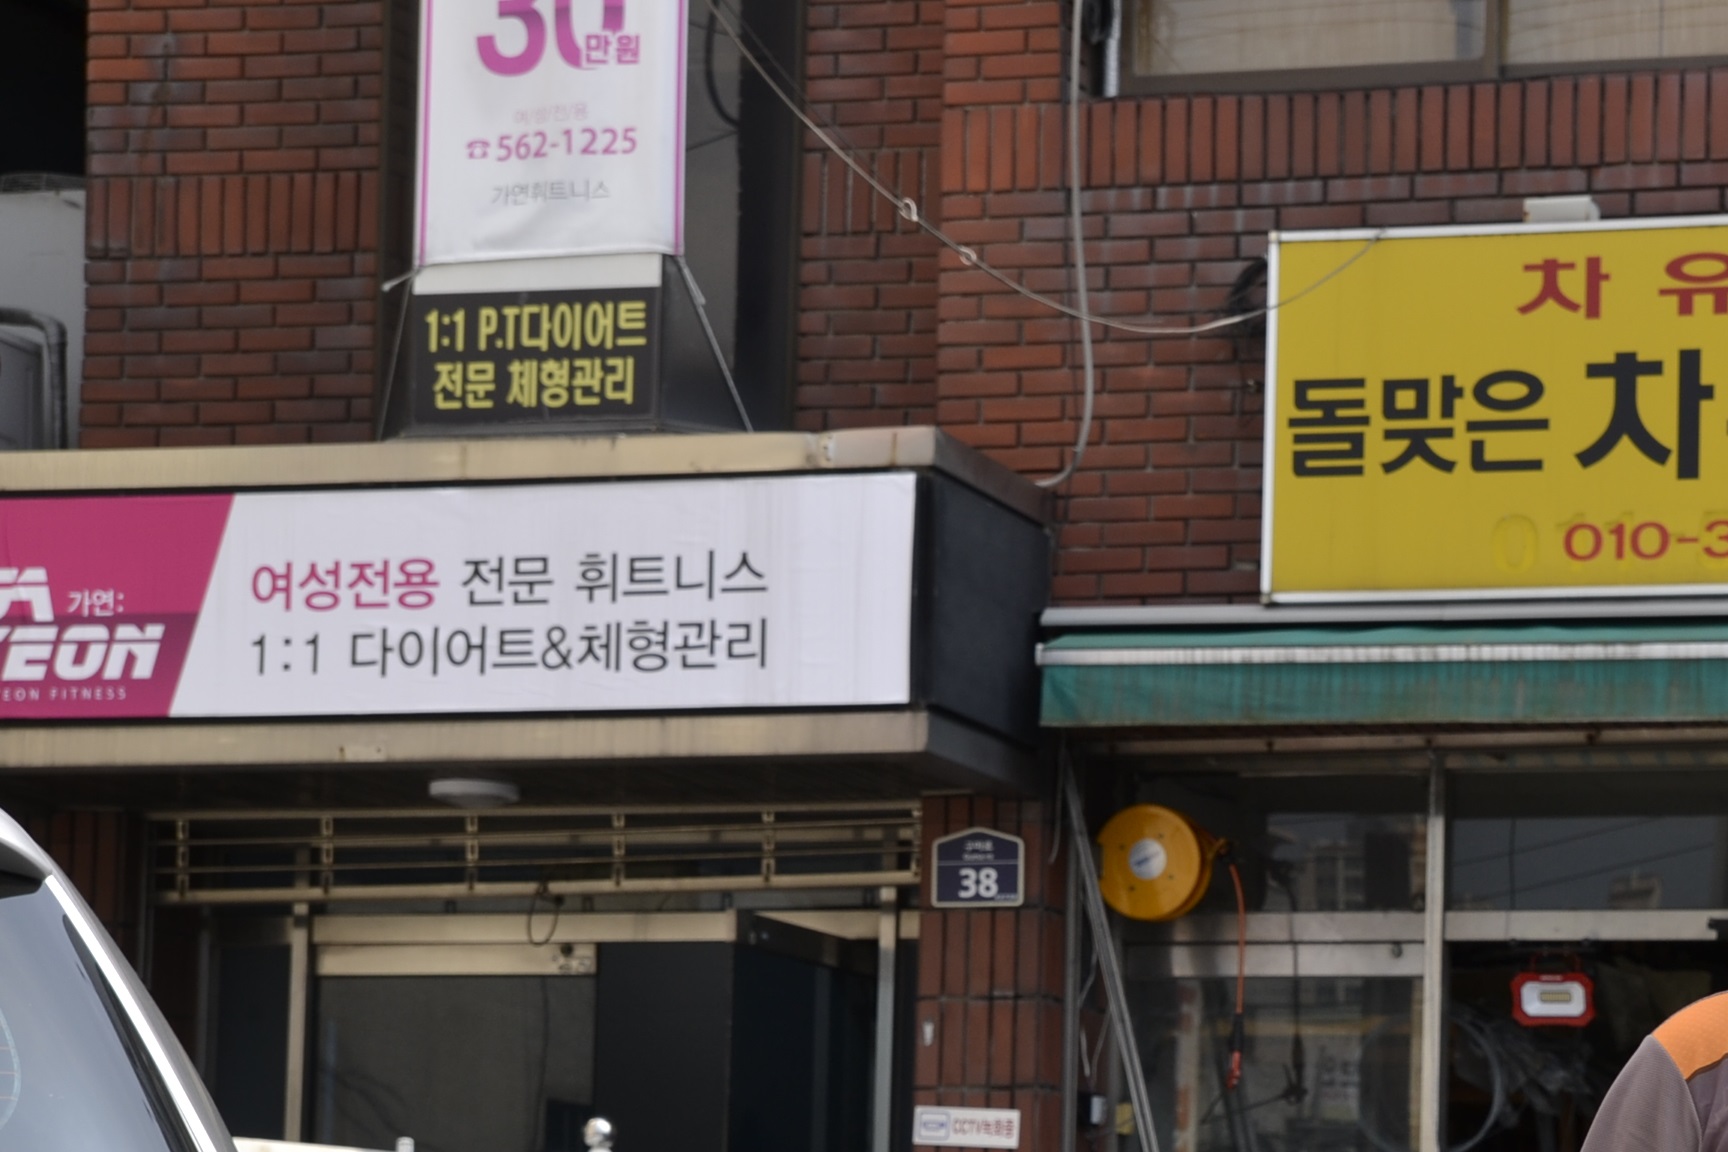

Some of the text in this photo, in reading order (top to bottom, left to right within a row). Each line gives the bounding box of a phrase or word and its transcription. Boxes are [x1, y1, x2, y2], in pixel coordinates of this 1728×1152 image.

[585, 33, 641, 65] 만원
[496, 127, 637, 162] 562-1225
[1516, 256, 1610, 318] 차
[425, 308, 466, 352] 1:1
[434, 355, 634, 409] 전문 체형관리
[1288, 369, 1550, 478] 돌맞은
[251, 549, 768, 611] 여성전용 전문 휘트니스
[251, 617, 769, 678] 1:1 다이어트&체형관리
[958, 867, 998, 898] 38
